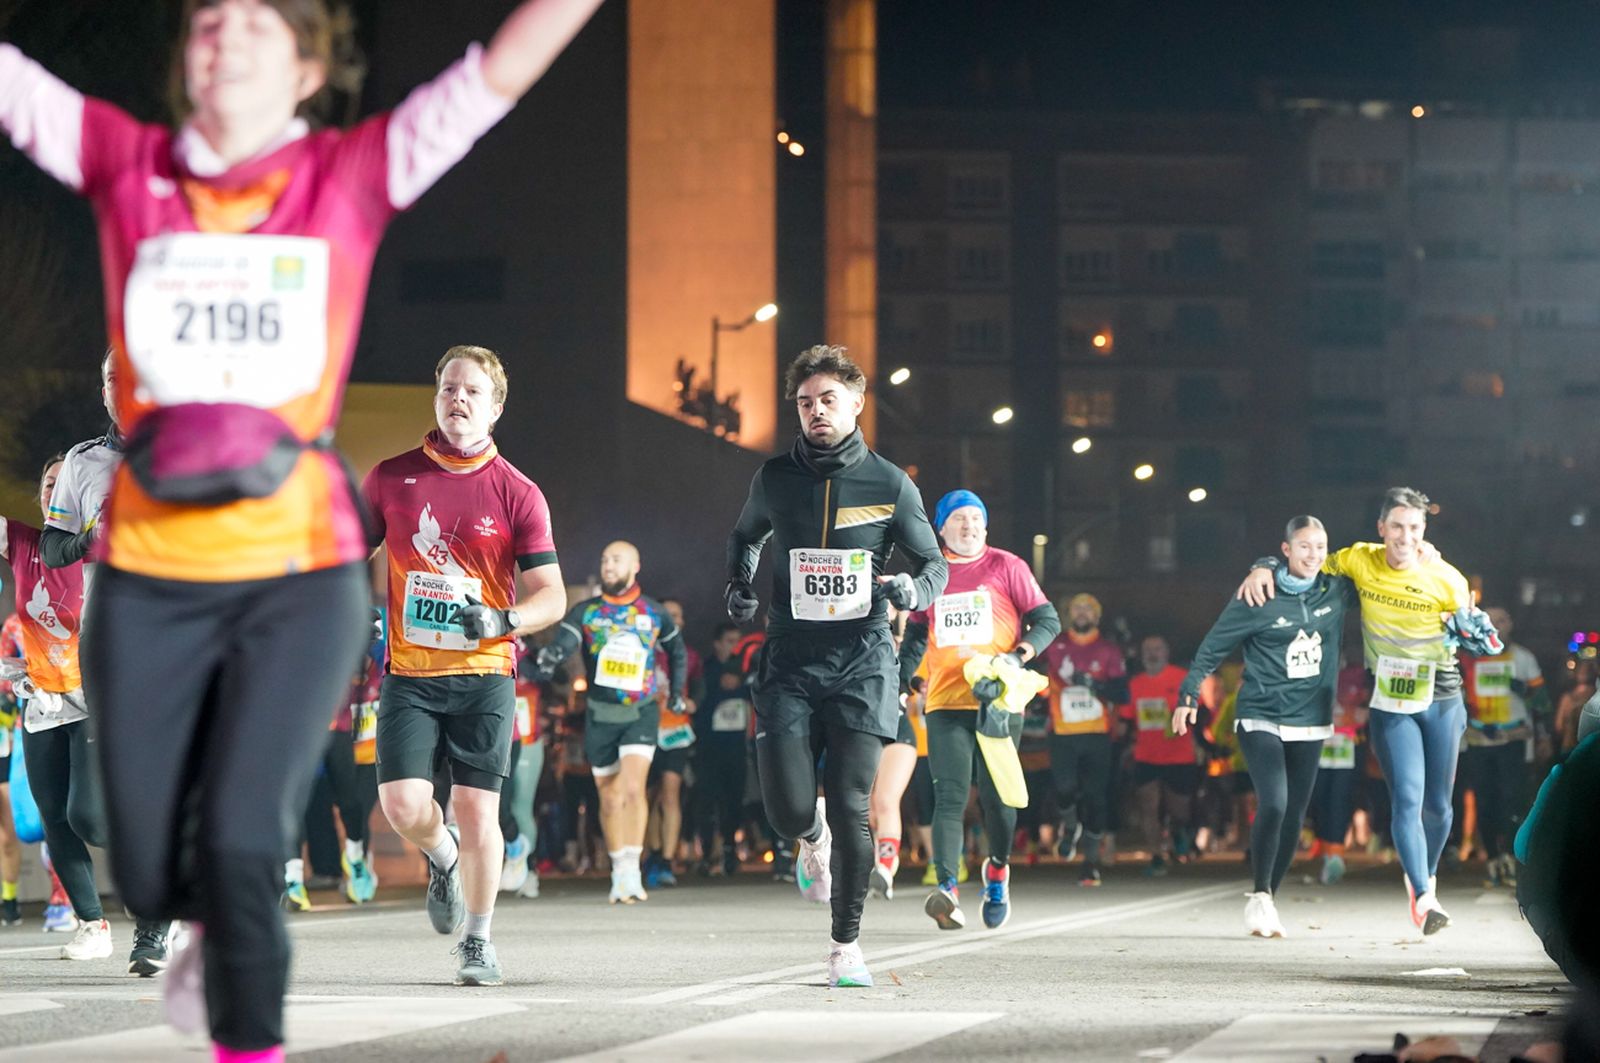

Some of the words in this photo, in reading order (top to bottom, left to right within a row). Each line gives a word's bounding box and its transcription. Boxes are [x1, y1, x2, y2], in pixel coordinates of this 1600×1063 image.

[173, 299, 281, 344] 2196
[427, 545, 449, 566] 43
[808, 556, 831, 565] NOCHE
[833, 557, 842, 565] DE
[799, 564, 814, 573] SAN
[413, 588, 428, 598] SAN
[421, 581, 444, 591] NOCHE
[805, 574, 857, 597] 6383
[39, 611, 56, 628] 43
[415, 598, 463, 625] 1202
[944, 611, 981, 628] 6332
[1390, 678, 1416, 695] 108
